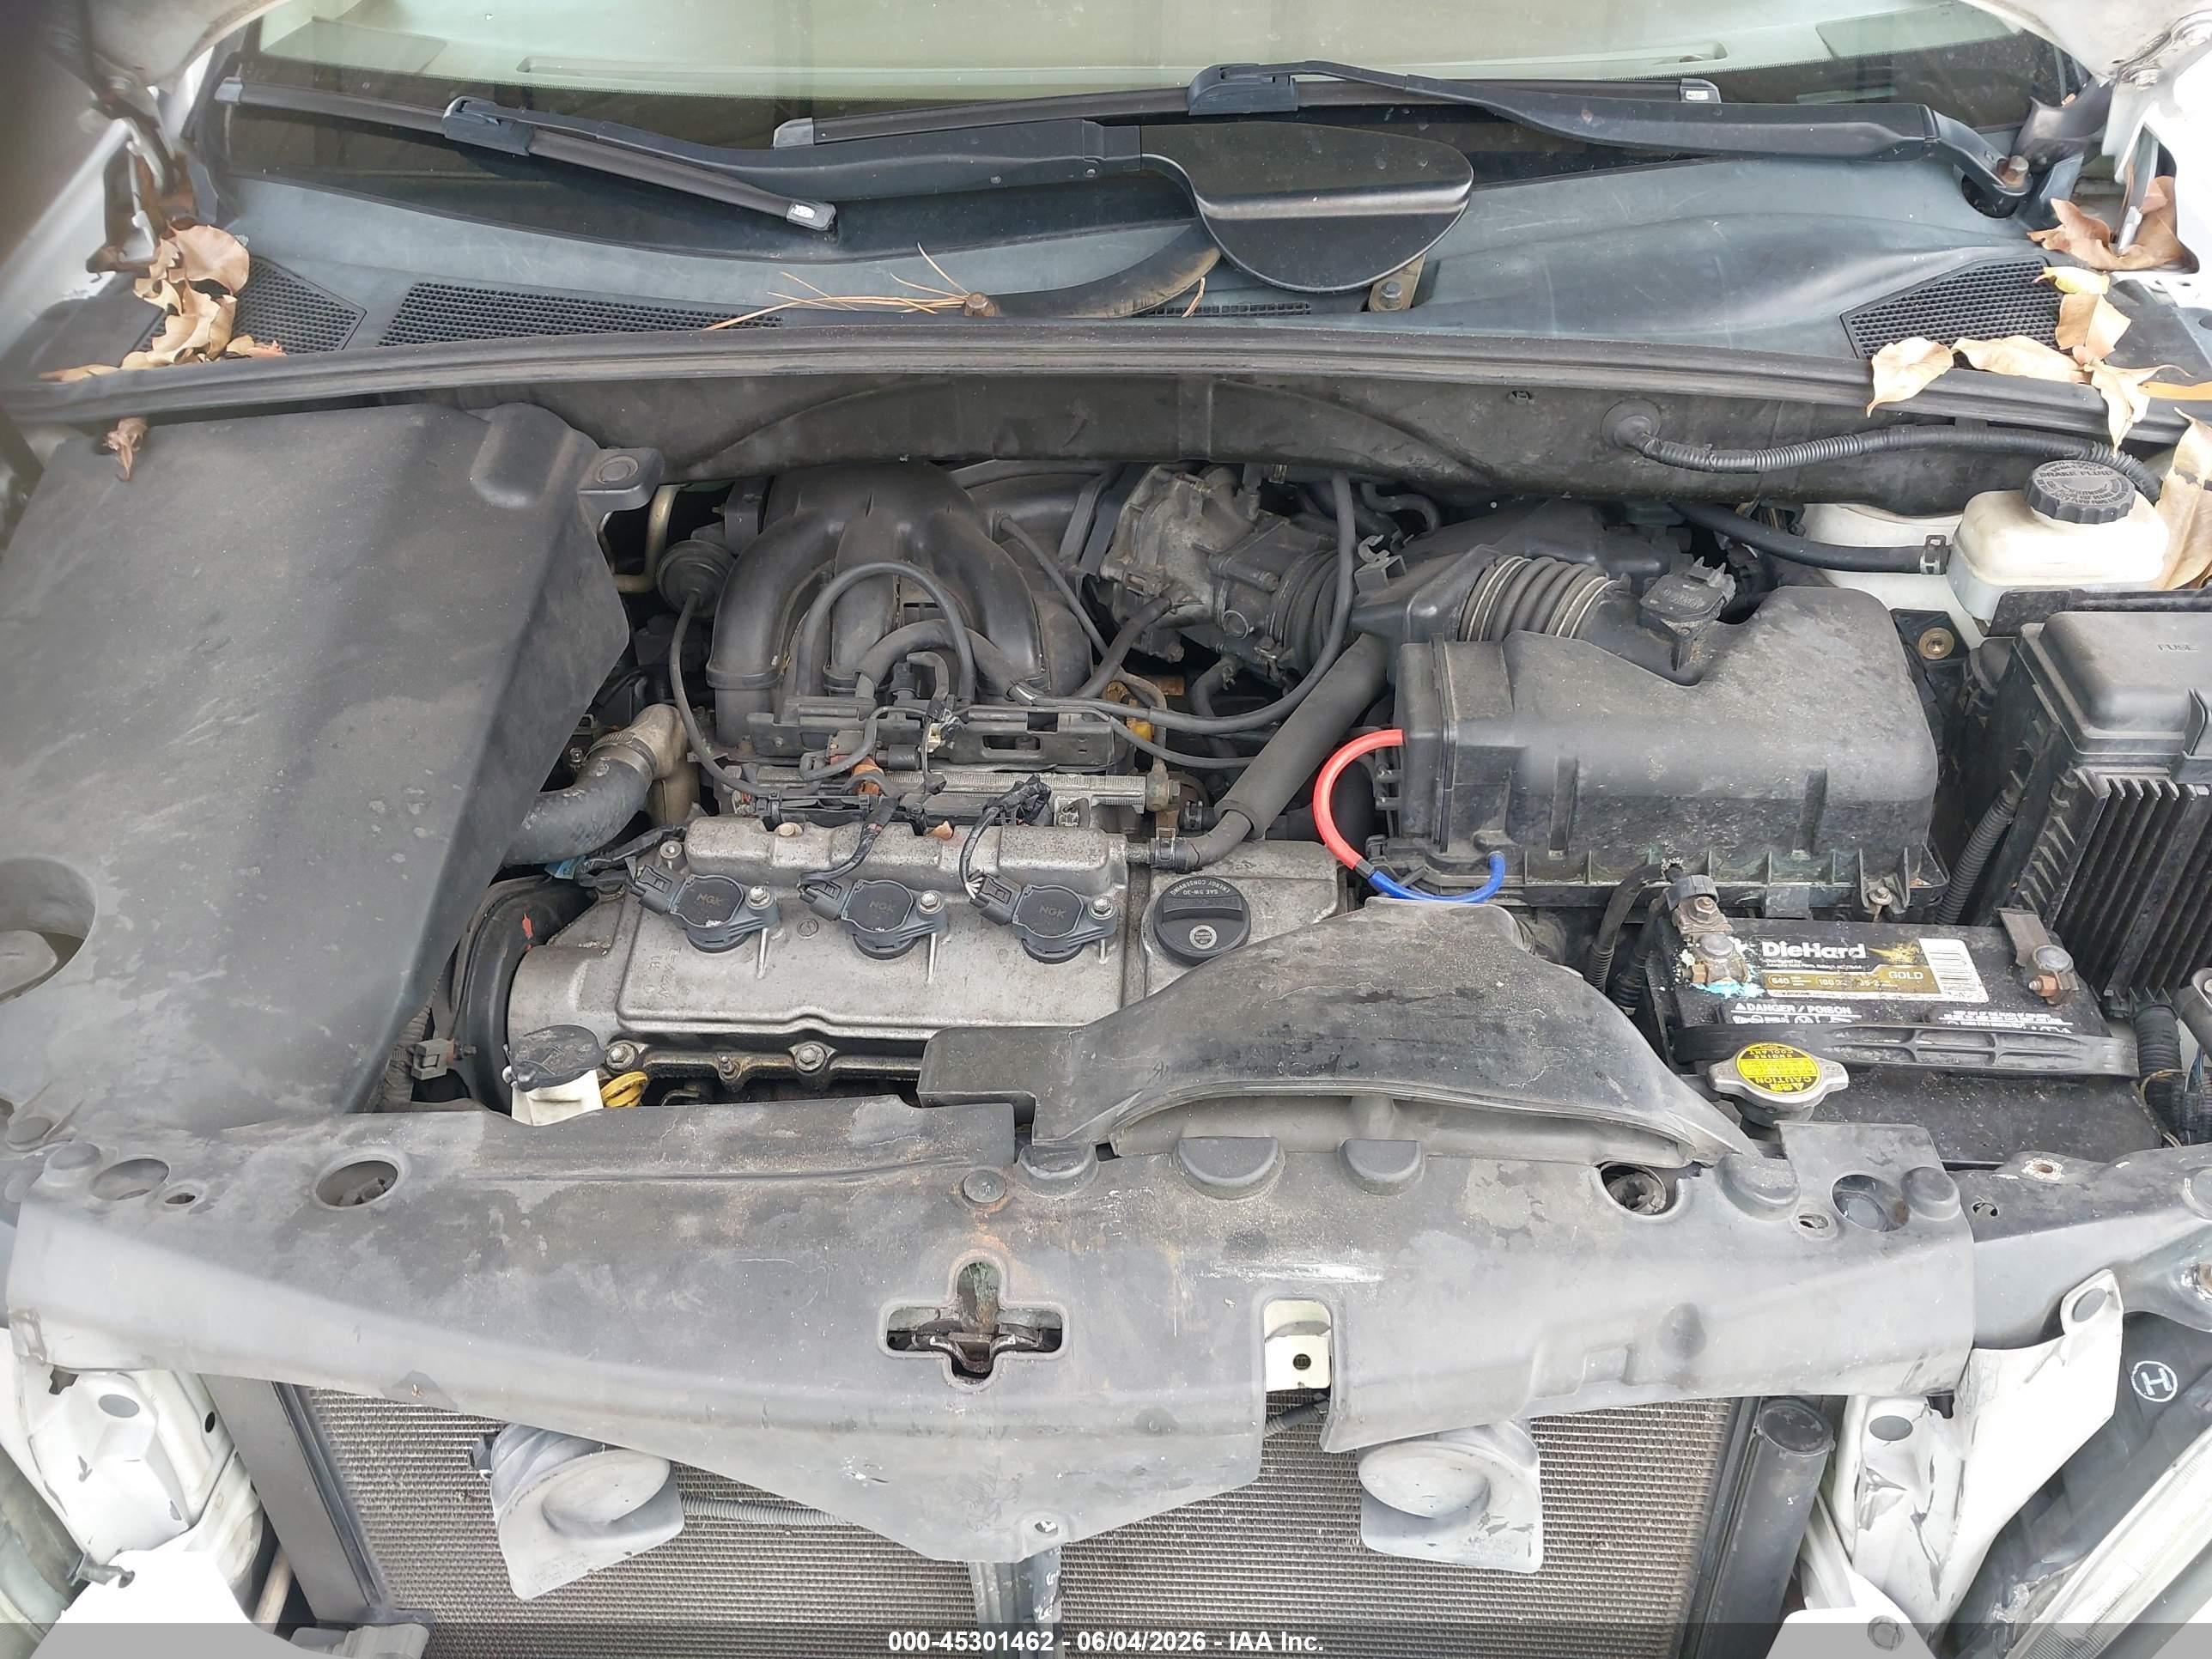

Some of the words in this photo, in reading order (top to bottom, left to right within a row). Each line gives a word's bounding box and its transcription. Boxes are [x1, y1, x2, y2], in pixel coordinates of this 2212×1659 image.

[2156, 642, 2199, 652] FUSE
[1169, 879, 1206, 896] CONSERVING
[1207, 880, 1231, 894] ENERGY
[696, 893, 724, 907] NGK
[869, 901, 897, 914] NGK
[1039, 904, 1067, 918] NGK
[1761, 940, 1867, 959] DieHard
[1888, 970, 1924, 981] GOLD
[1747, 1003, 1796, 1013] DANGER
[1806, 1005, 1852, 1014] POISON
[1754, 1076, 1813, 1085] CAUTION
